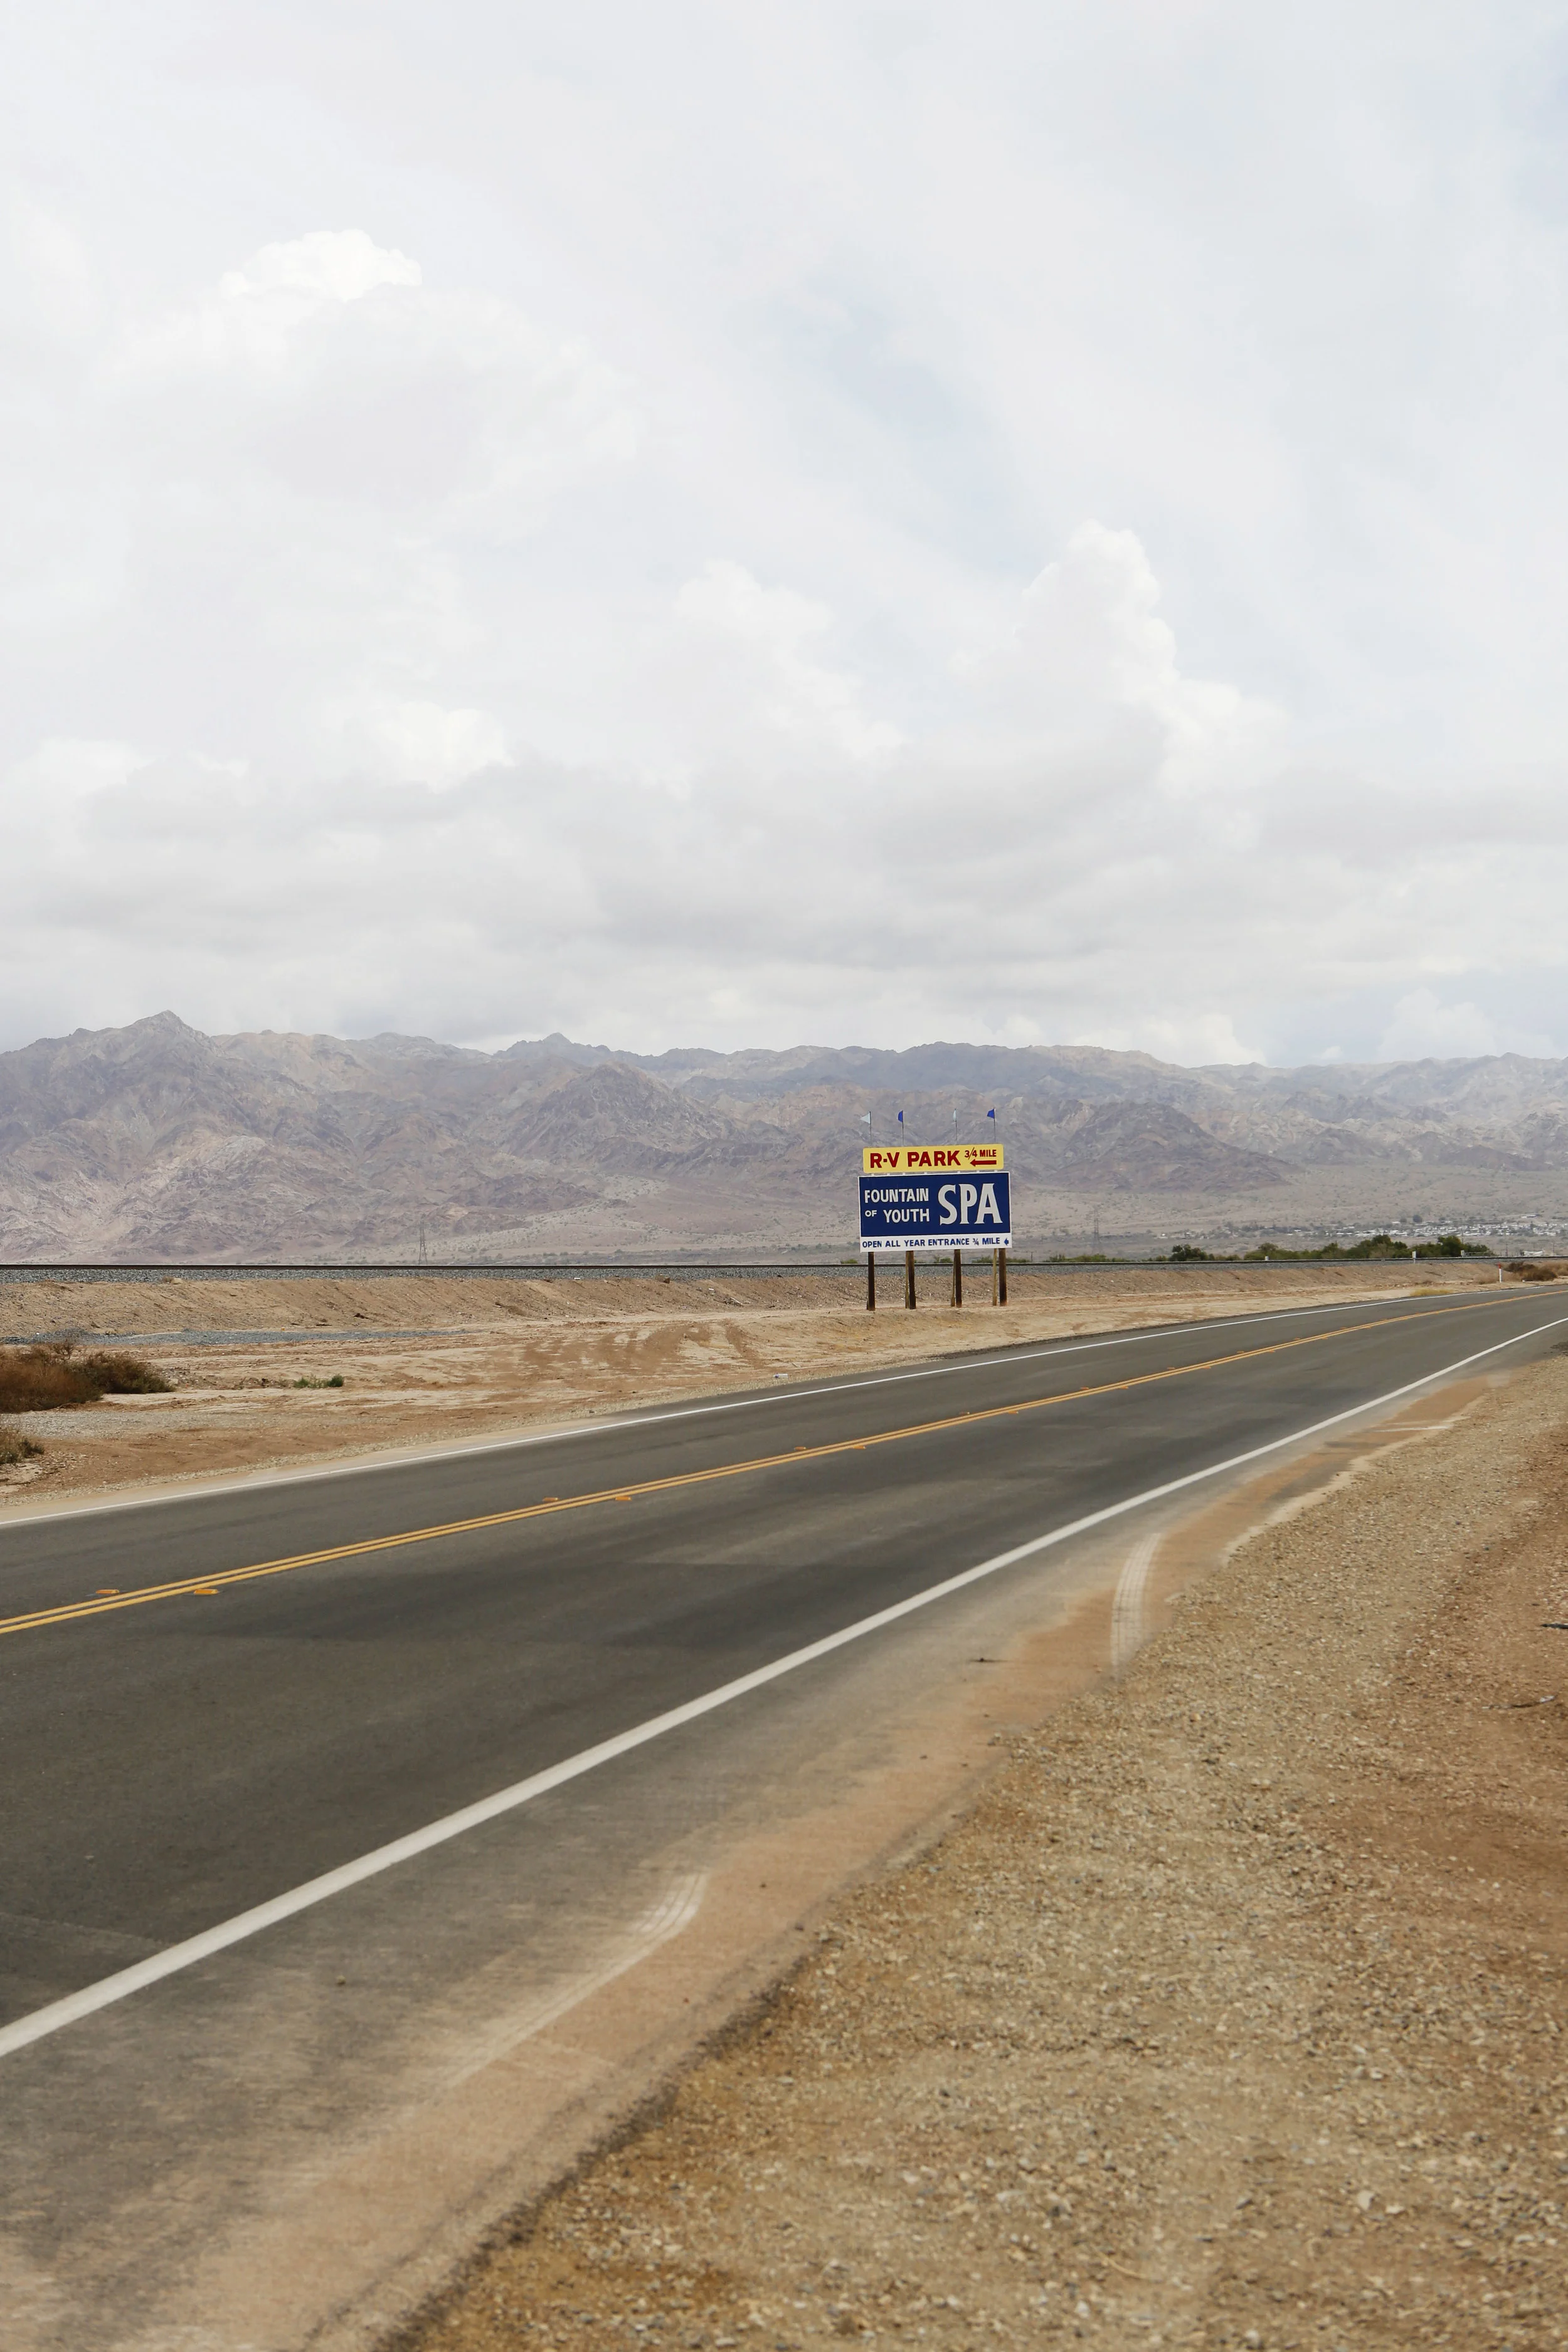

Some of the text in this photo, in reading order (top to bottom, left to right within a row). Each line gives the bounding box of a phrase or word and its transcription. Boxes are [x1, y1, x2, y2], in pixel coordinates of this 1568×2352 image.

[870, 1150, 961, 1168] R-V PARK
[965, 1147, 997, 1160] 3/4 MILE
[864, 1188, 929, 1203] FOUNTAIN
[938, 1183, 1004, 1226] SPA
[883, 1208, 930, 1223] YOUTH
[885, 1239, 901, 1248] ALL
[928, 1238, 970, 1246] ENTRANCE
[982, 1237, 1000, 1245] MILE
